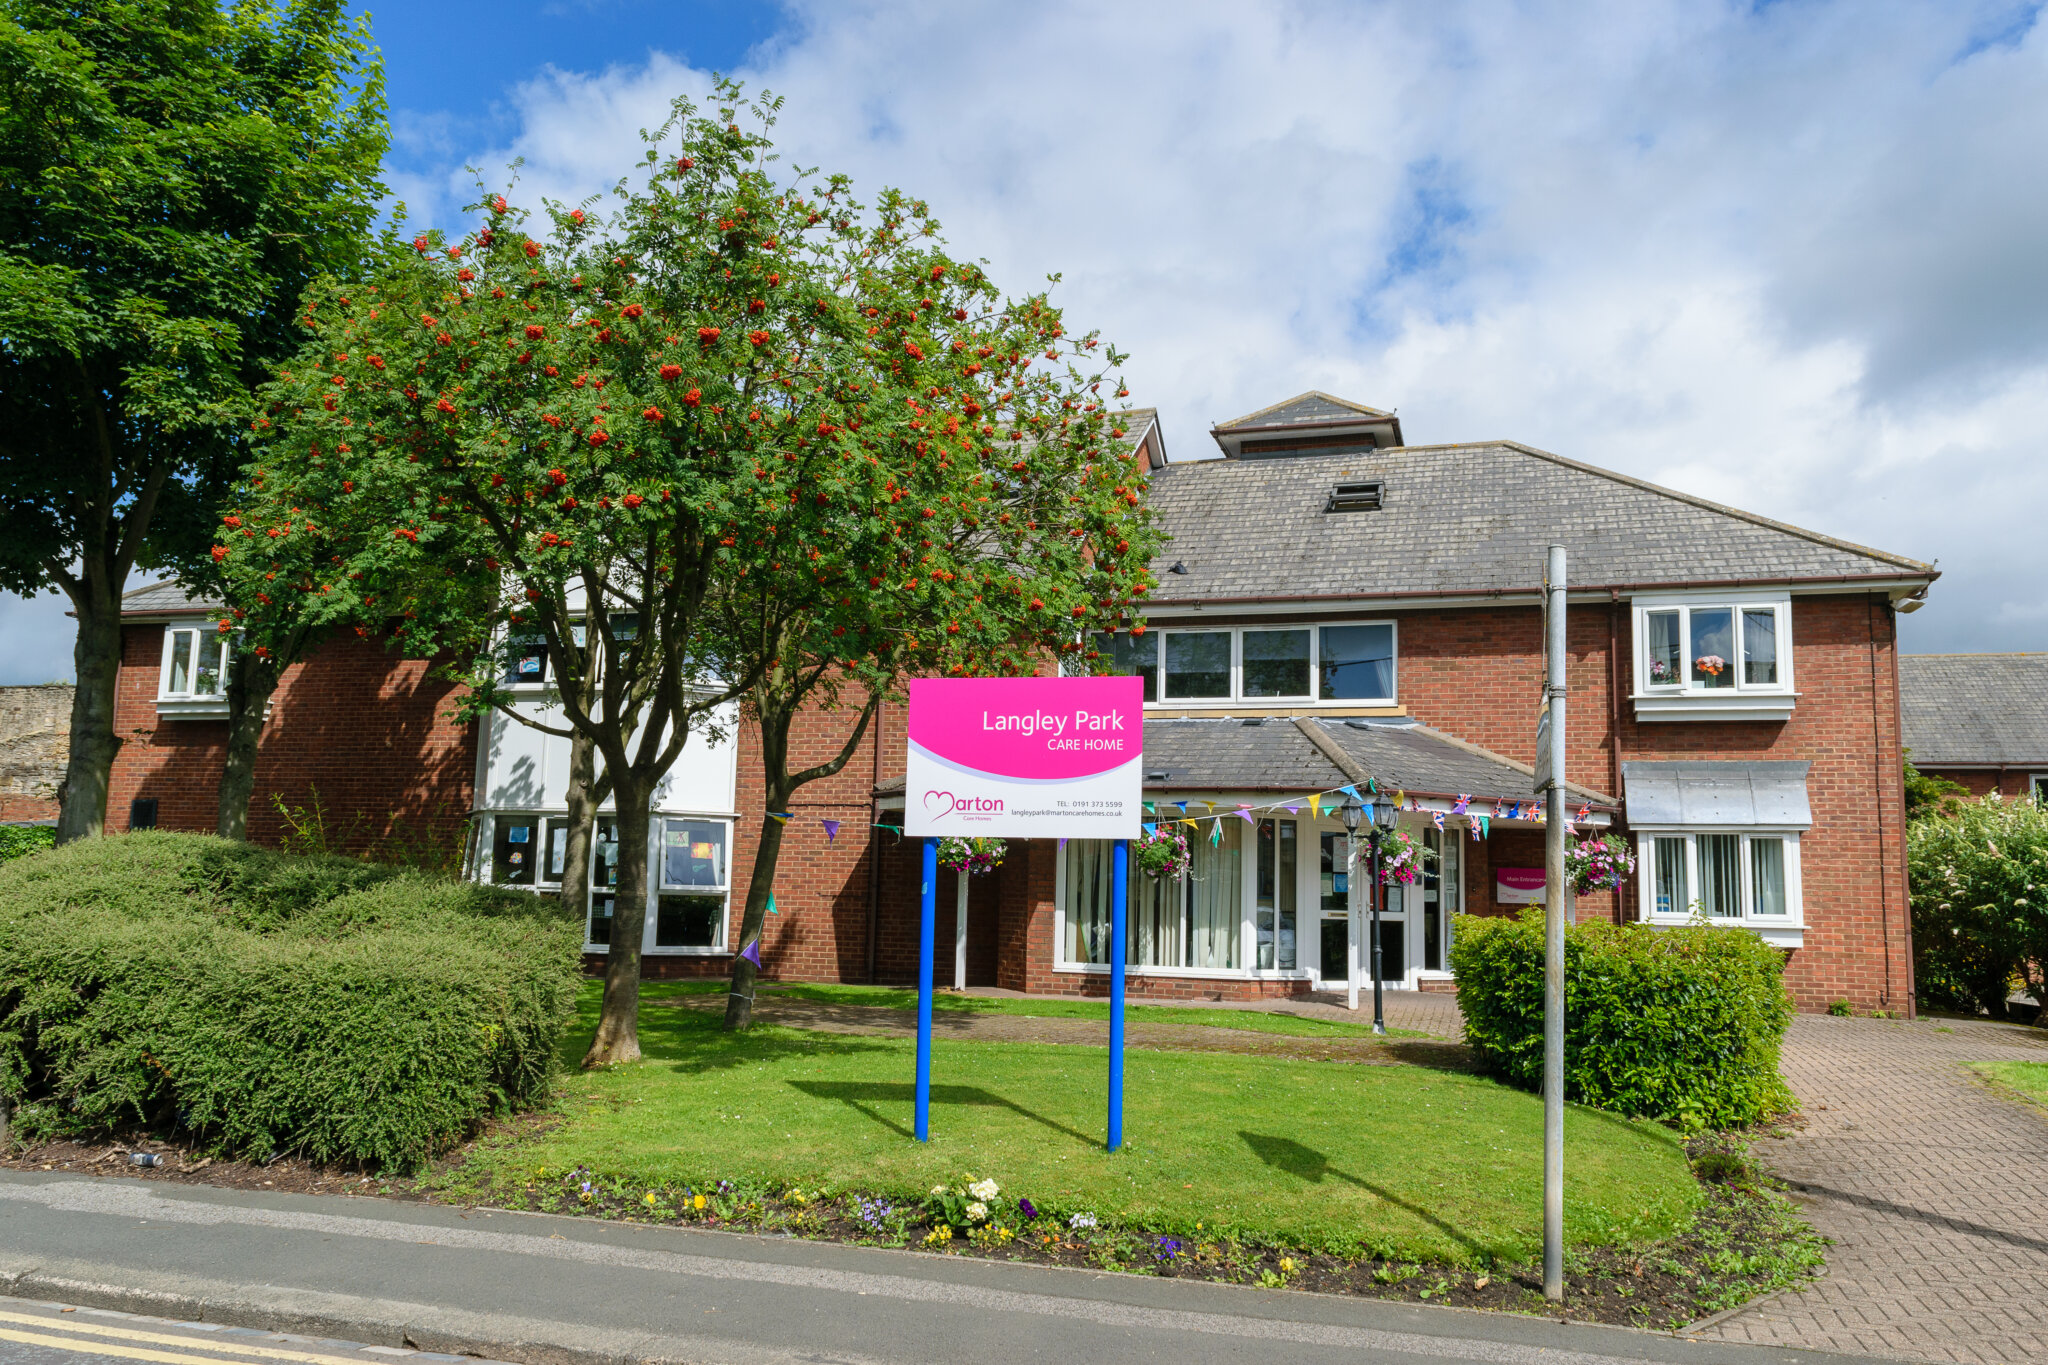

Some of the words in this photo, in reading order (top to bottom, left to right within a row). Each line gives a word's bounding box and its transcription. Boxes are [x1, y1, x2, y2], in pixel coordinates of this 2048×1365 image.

[983, 709, 1068, 736] Langley
[1075, 709, 1124, 731] Park
[1047, 739, 1081, 751] CARE
[1084, 739, 1124, 751] HOME
[1056, 800, 1070, 808] TEL:
[1072, 800, 1089, 808] 0191
[1011, 809, 1123, 817] langleypark@martoncarehomes.co.uk
